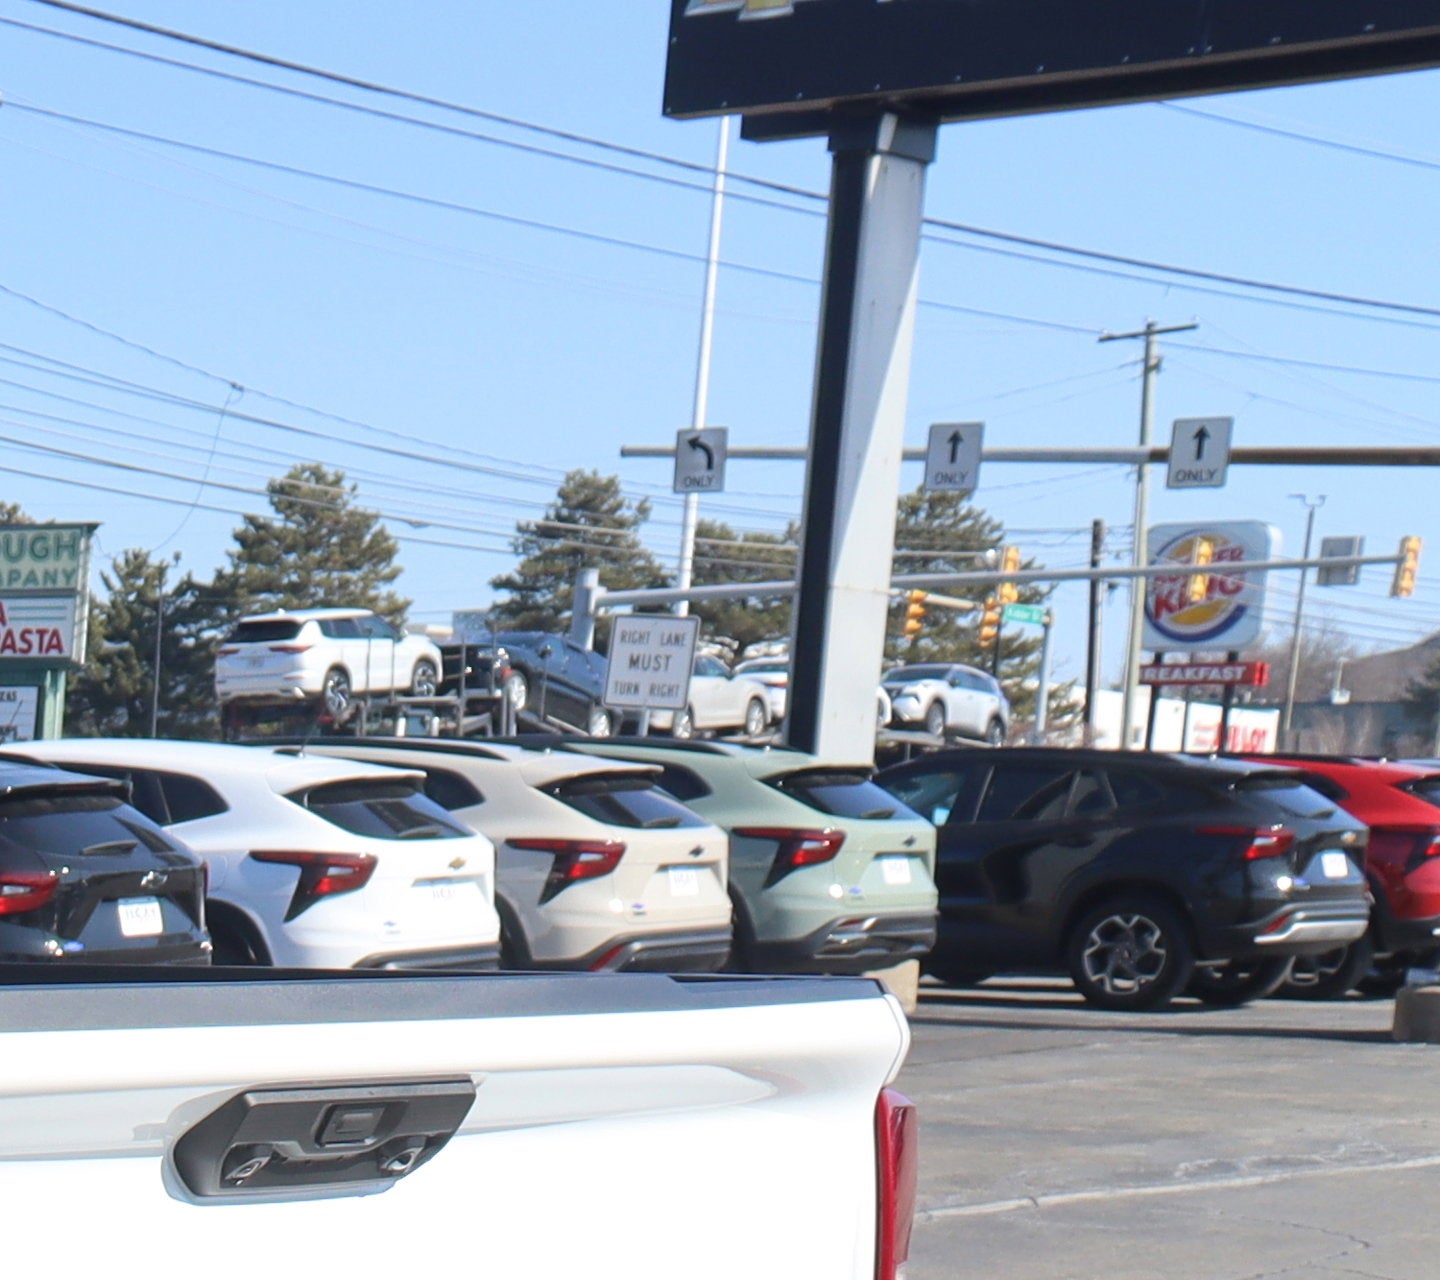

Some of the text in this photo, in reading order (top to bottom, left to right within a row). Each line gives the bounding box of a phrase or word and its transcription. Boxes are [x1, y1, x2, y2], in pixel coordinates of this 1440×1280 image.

[684, 475, 715, 487] ONLY
[934, 471, 969, 485] ONLY
[1175, 468, 1218, 482] ONLY
[620, 630, 686, 646] RIGHT LANE
[629, 654, 672, 671] MUST
[1142, 665, 1247, 681] REAKFAST
[614, 681, 679, 697] TURN RIGHT
